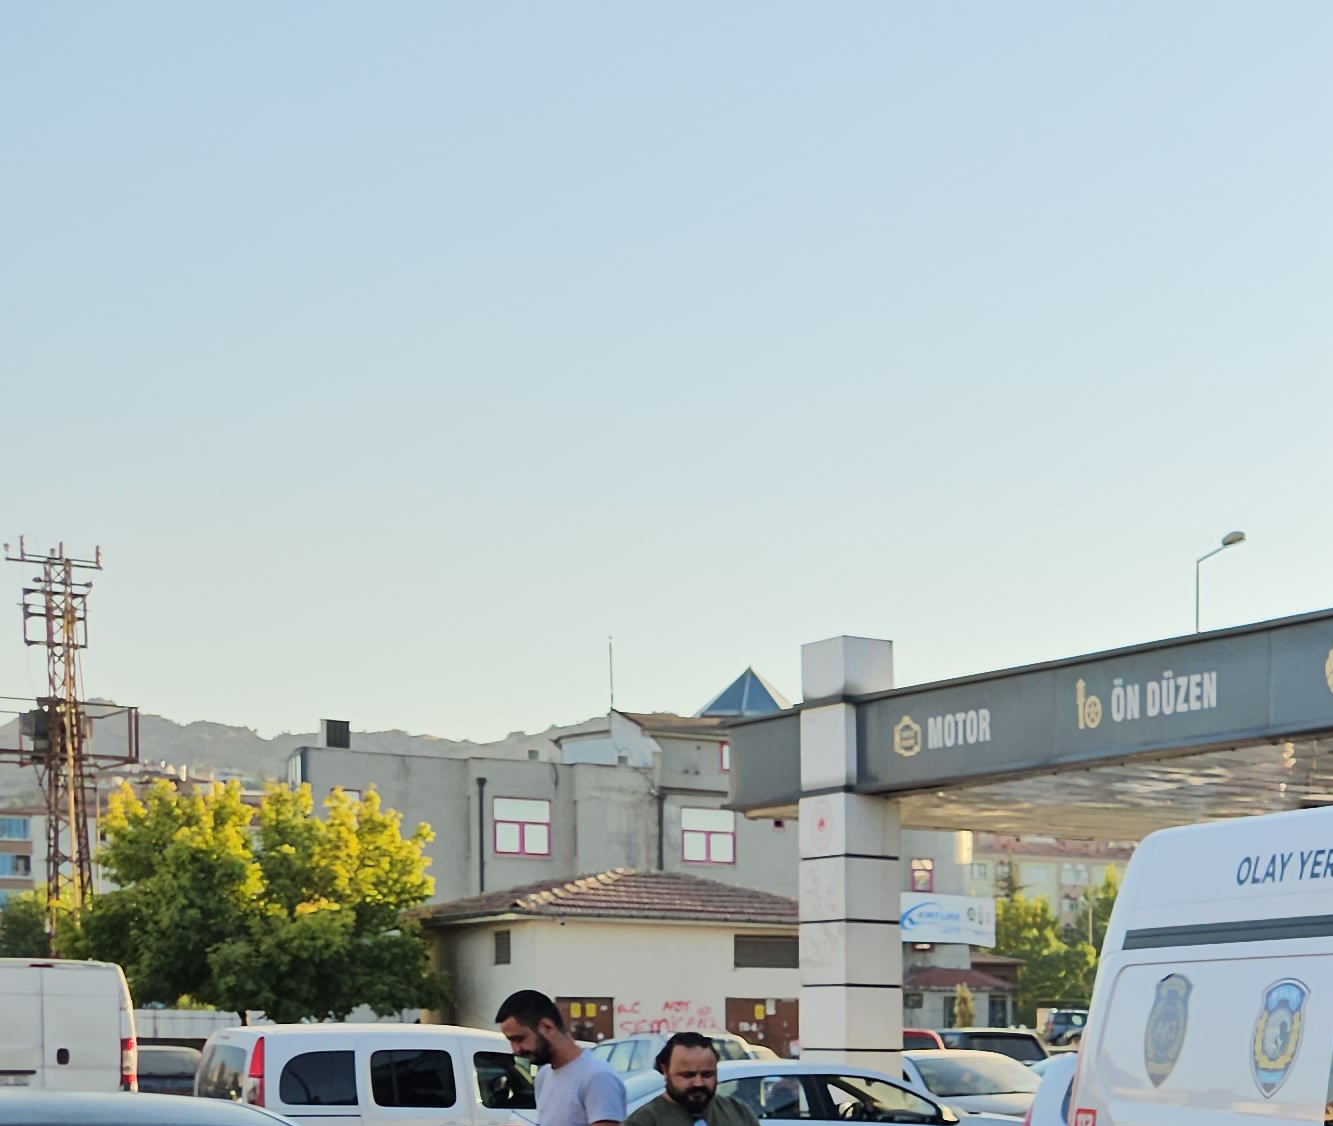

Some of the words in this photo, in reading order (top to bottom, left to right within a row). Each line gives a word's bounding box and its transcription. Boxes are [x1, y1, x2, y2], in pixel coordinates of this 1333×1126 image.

[1111, 676, 1141, 723] ÖN
[1147, 669, 1218, 717] DÜZEN
[927, 707, 992, 750] MOTOR
[1236, 852, 1293, 886] OLAY
